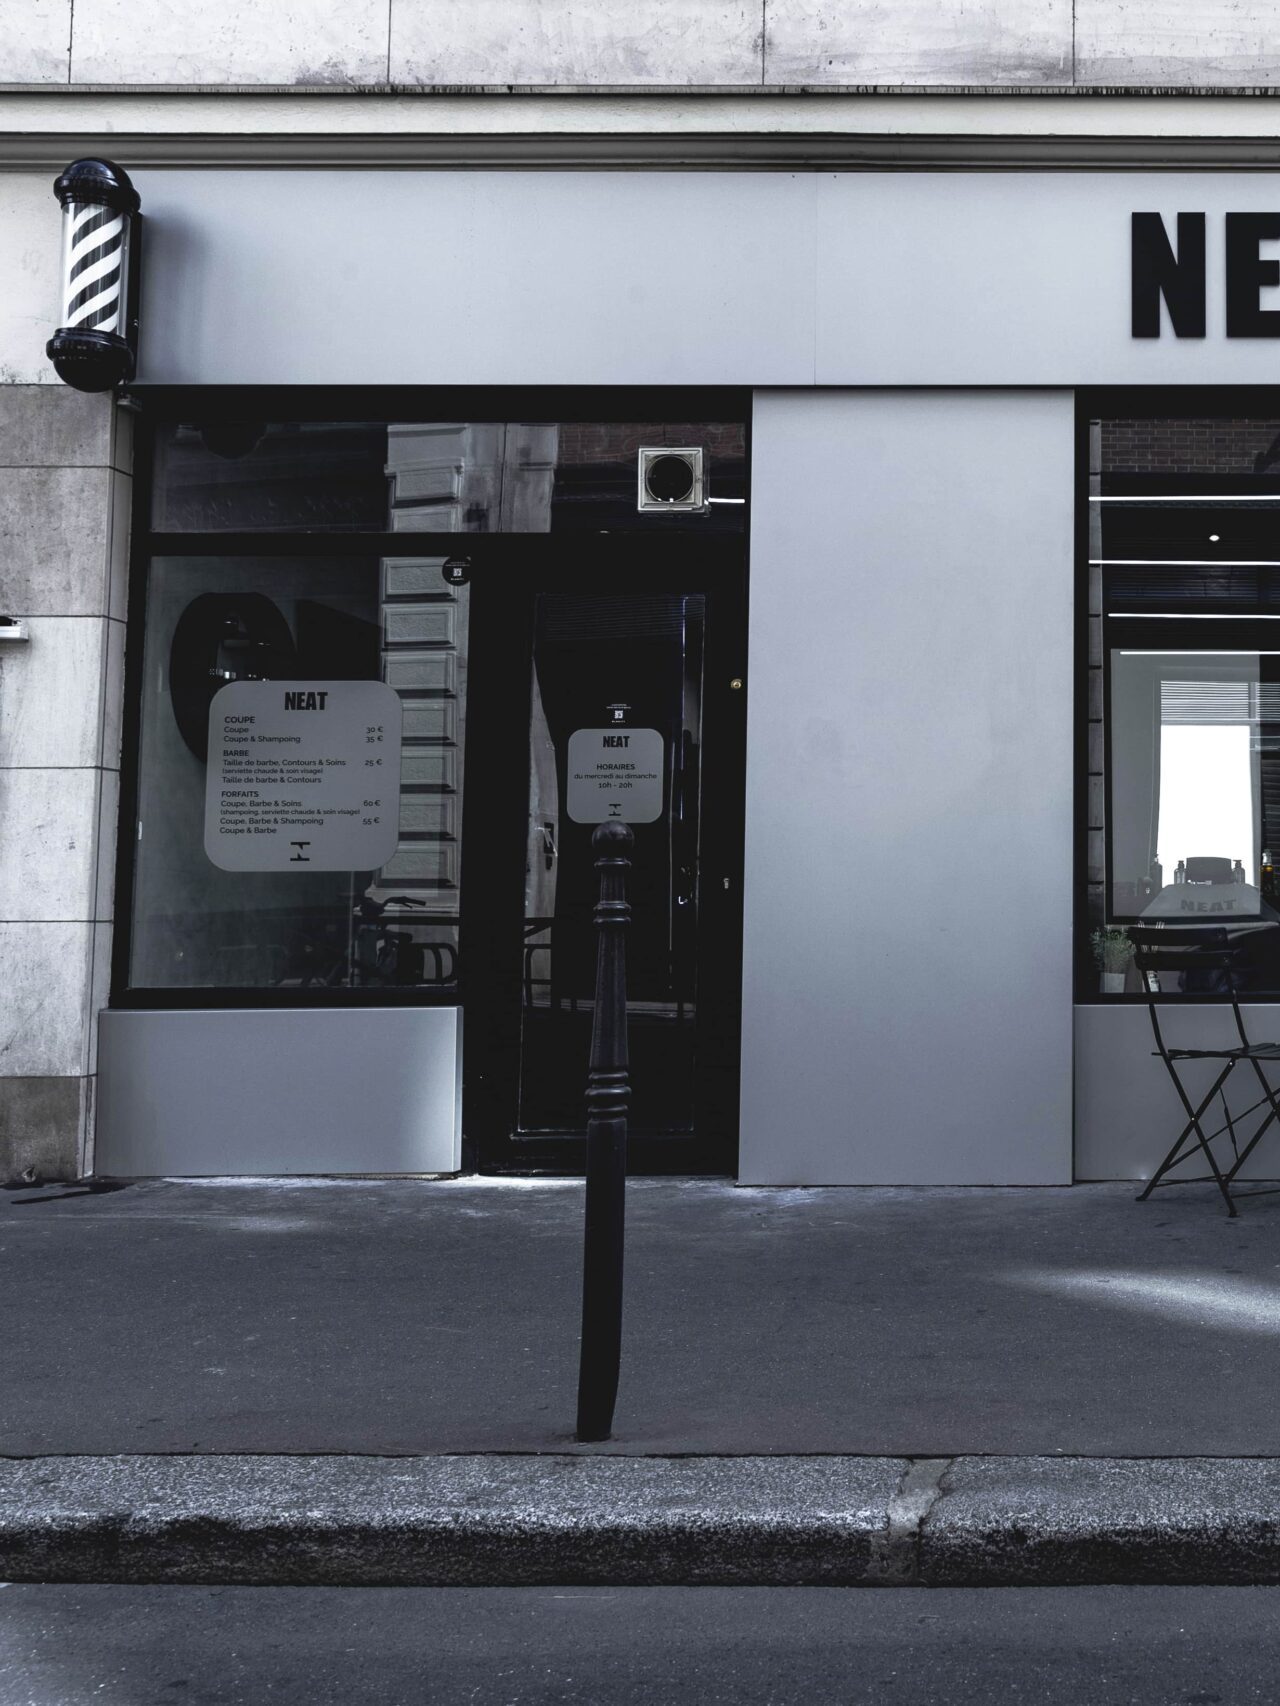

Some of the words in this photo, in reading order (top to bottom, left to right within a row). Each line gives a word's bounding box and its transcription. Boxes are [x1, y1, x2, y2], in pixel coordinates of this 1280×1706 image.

[284, 691, 328, 710] NEAT
[224, 716, 256, 724] COUPE
[224, 726, 249, 734] Coupe
[223, 735, 249, 743] Coupe
[257, 735, 301, 744] Shampoing
[602, 735, 631, 748] NEAT
[596, 763, 636, 771] HORAIRES
[222, 776, 243, 784] Taille
[244, 776, 254, 784] de
[255, 776, 278, 784] barbe
[280, 776, 286, 784] &
[287, 776, 322, 784] Contours
[280, 817, 324, 826] Shampoing
[362, 818, 372, 826] 55
[219, 827, 245, 835] Coupe
[253, 826, 277, 834] Barbe
[1180, 899, 1237, 913] NEAT
